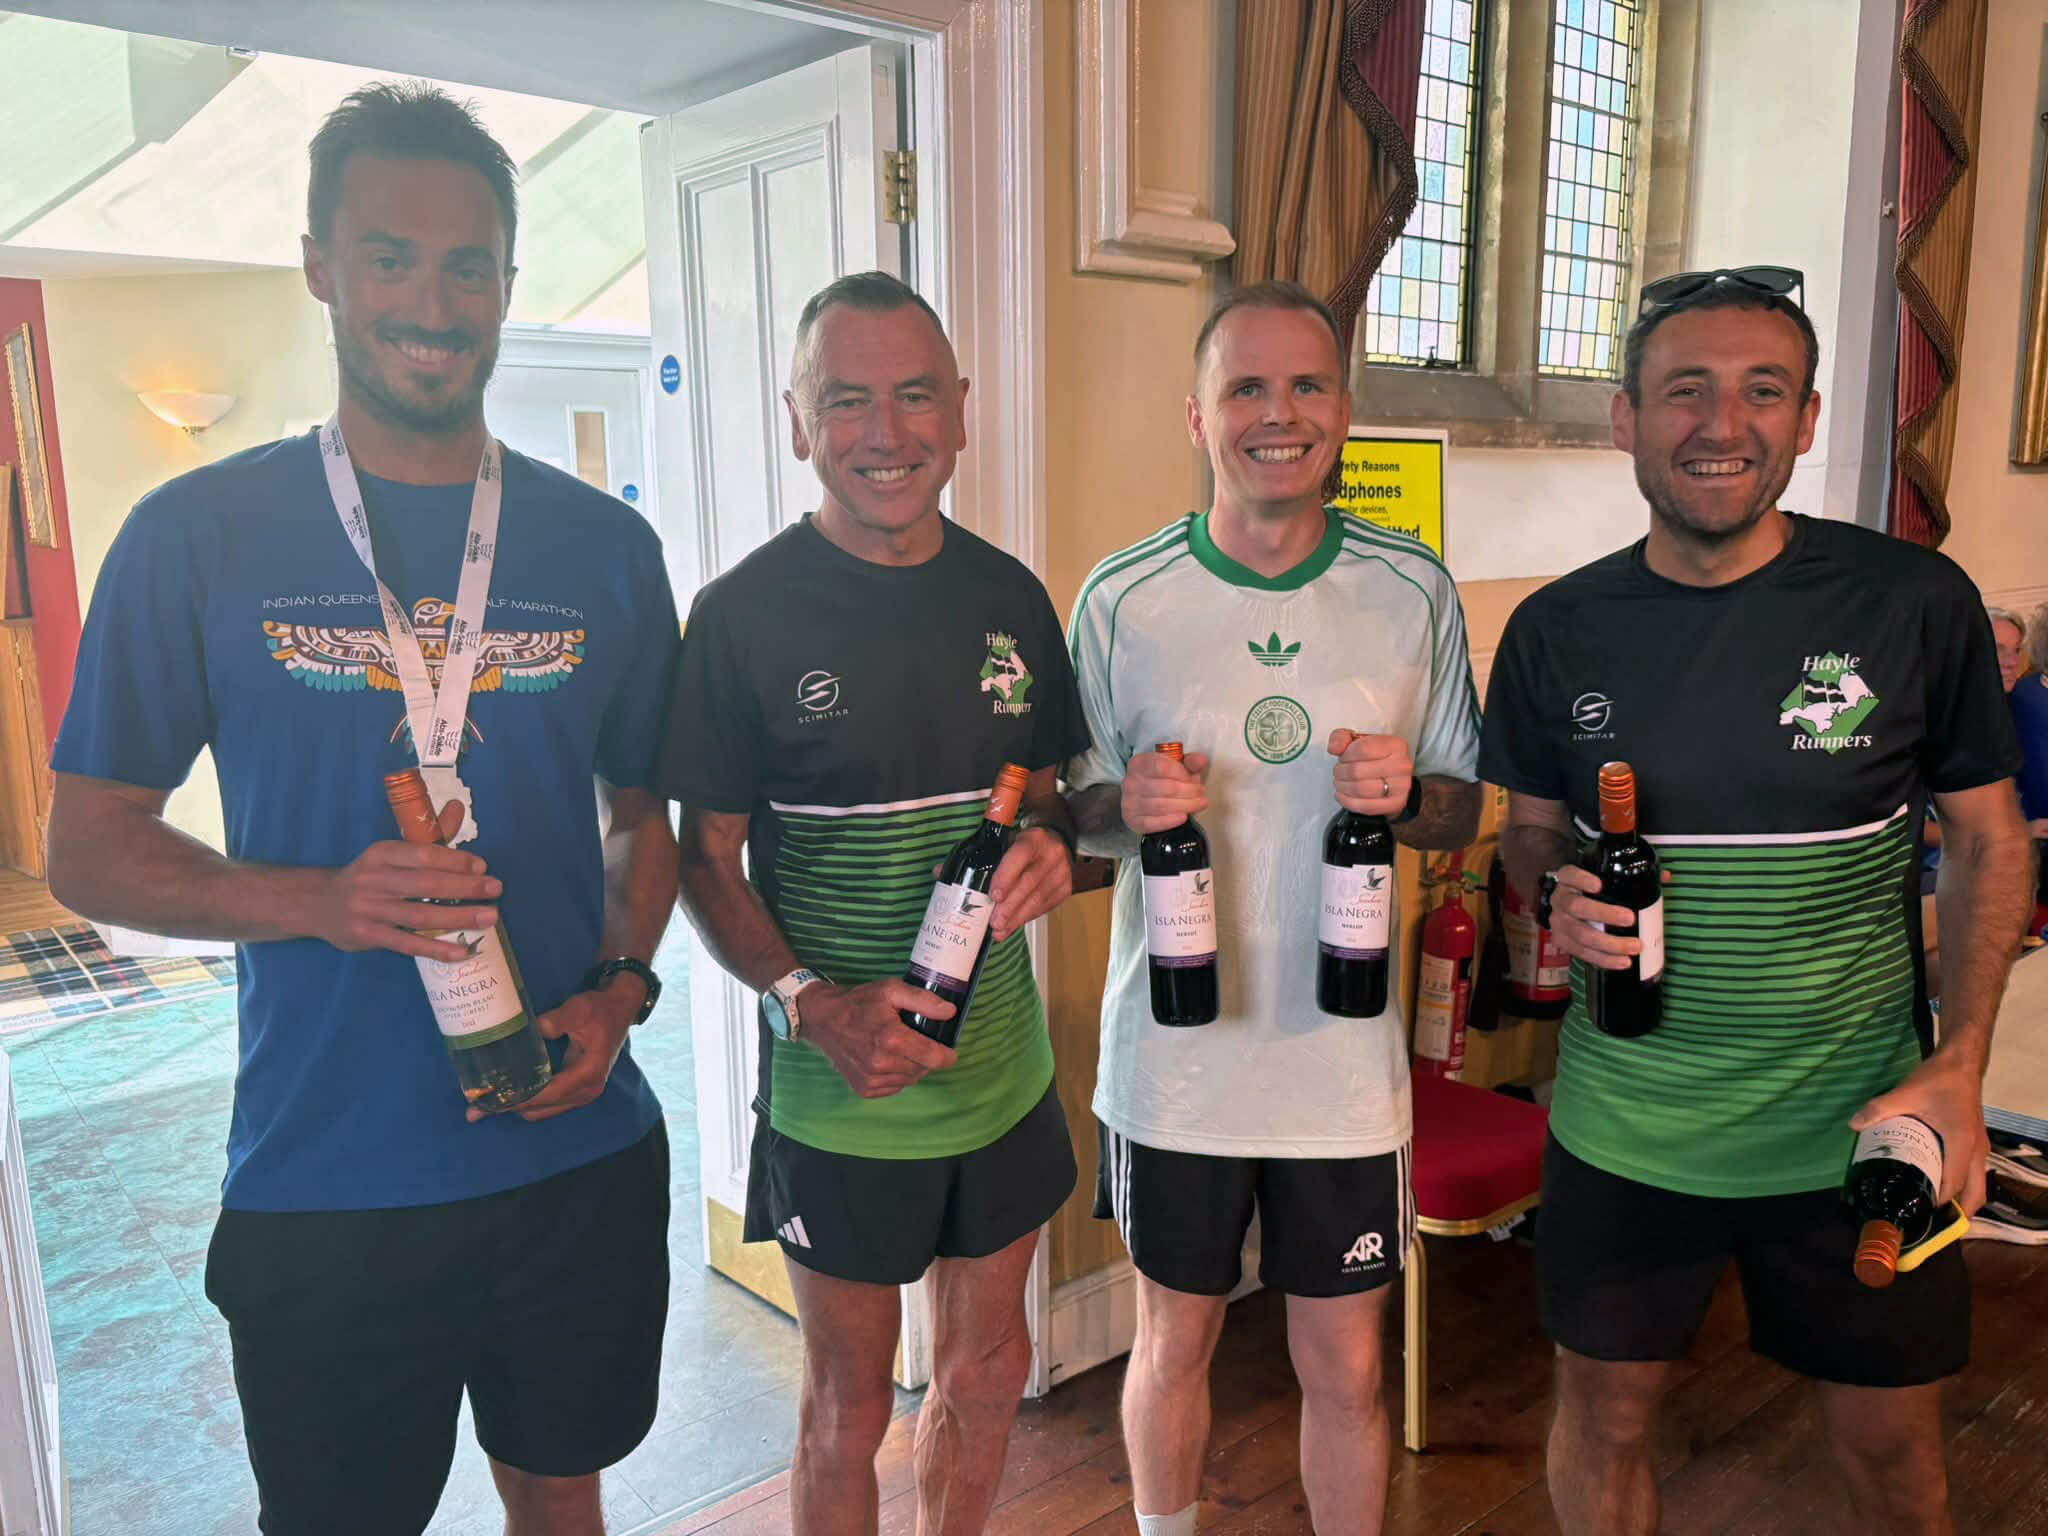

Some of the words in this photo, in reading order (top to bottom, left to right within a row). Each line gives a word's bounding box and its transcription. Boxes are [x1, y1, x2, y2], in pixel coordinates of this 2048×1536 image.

[1340, 460, 1360, 474] fety
[1361, 460, 1400, 473] Reasons
[1339, 482, 1401, 502] dphones
[263, 595, 315, 609] INDIAN
[318, 593, 381, 607] QUEENS
[511, 599, 584, 620] MARATHON
[985, 632, 1018, 650] Hayle
[1803, 653, 1861, 673] Hayle
[798, 708, 849, 724] SCIMITAR
[1572, 732, 1616, 742] SCIMITAR
[1792, 732, 1873, 751] Runners
[1154, 915, 1176, 926] ISLA
[1178, 913, 1212, 926] NEGRA
[1324, 903, 1344, 917] ISLA
[1344, 907, 1383, 919] NEGRA
[448, 976, 498, 1000] NEGRA
[1871, 1129, 1920, 1144] NEGRA
[1343, 1232, 1385, 1264] AR
